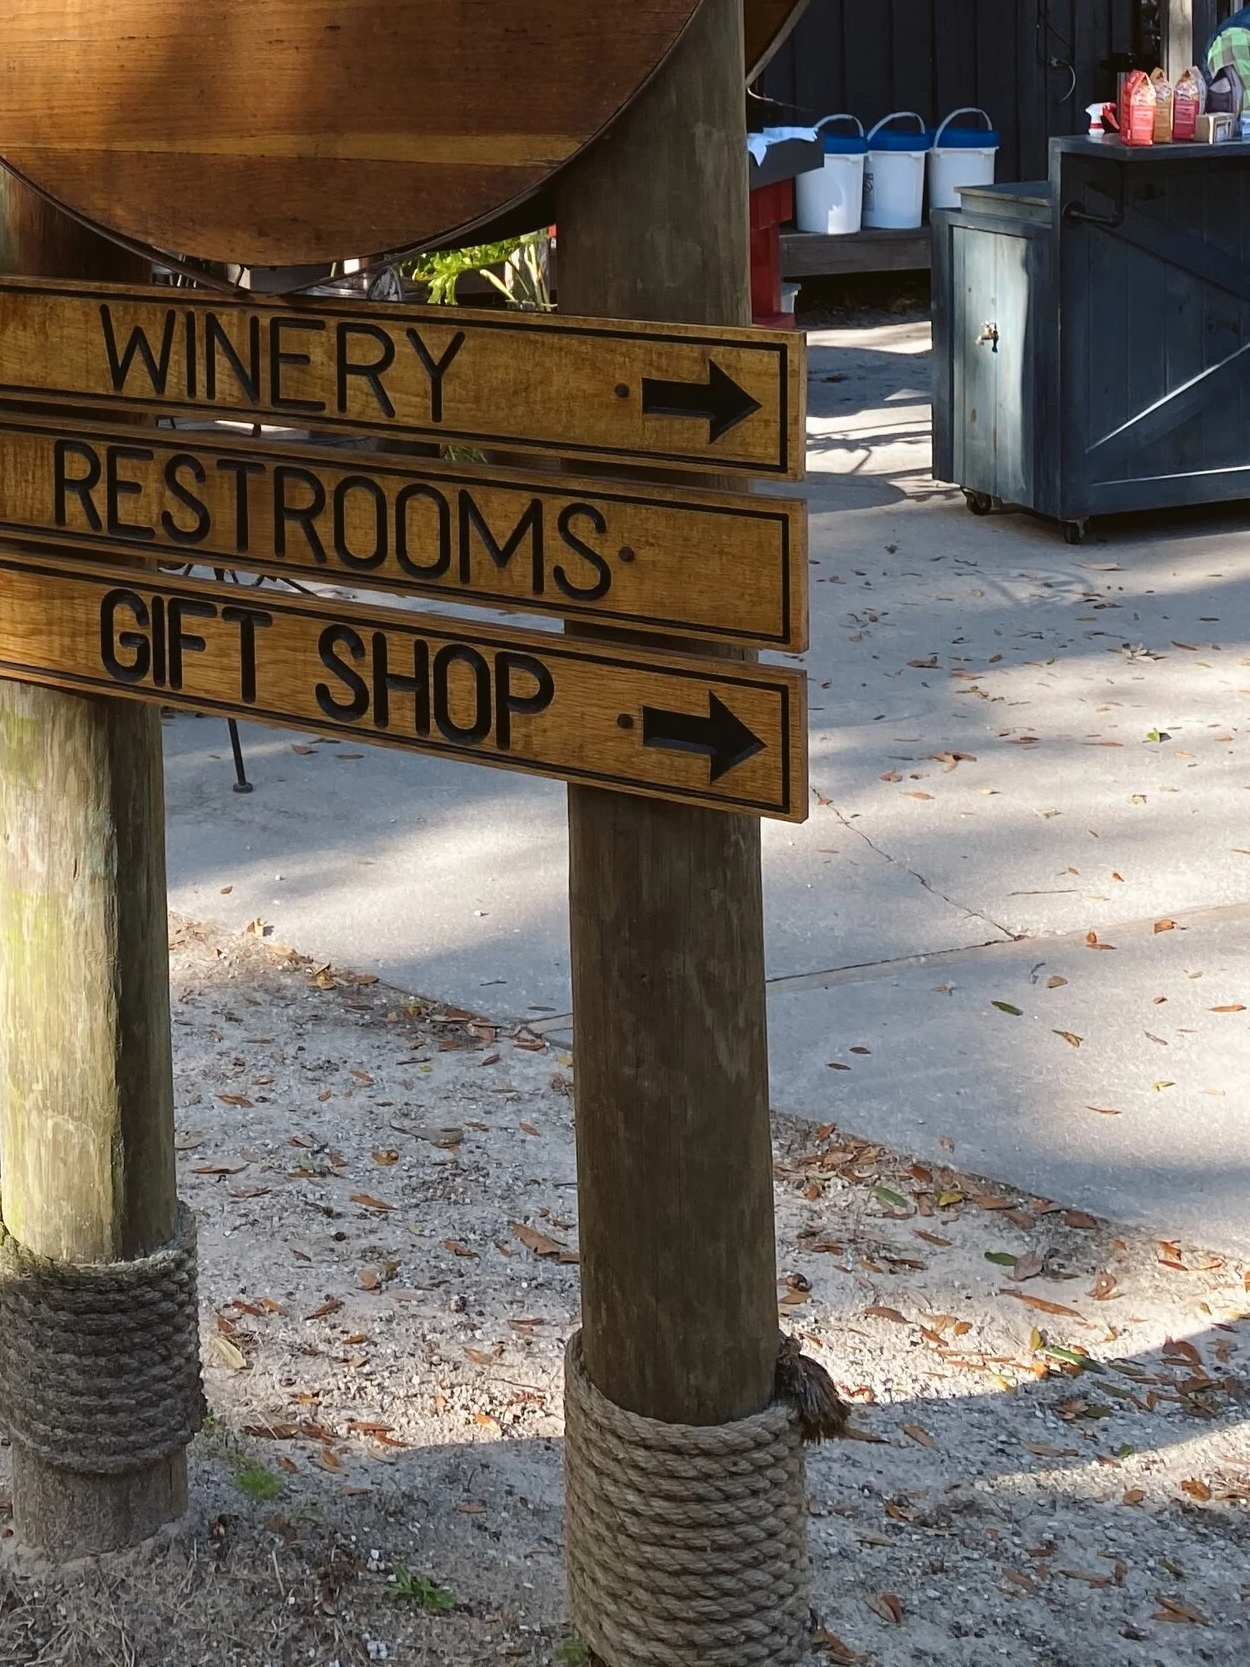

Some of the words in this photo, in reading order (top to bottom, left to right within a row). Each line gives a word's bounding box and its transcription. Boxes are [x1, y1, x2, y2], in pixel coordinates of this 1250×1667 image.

[99, 303, 466, 423] WINERY
[53, 439, 613, 602] RESTROOMS
[99, 588, 273, 704] GIFT
[315, 623, 555, 751] SHOP
